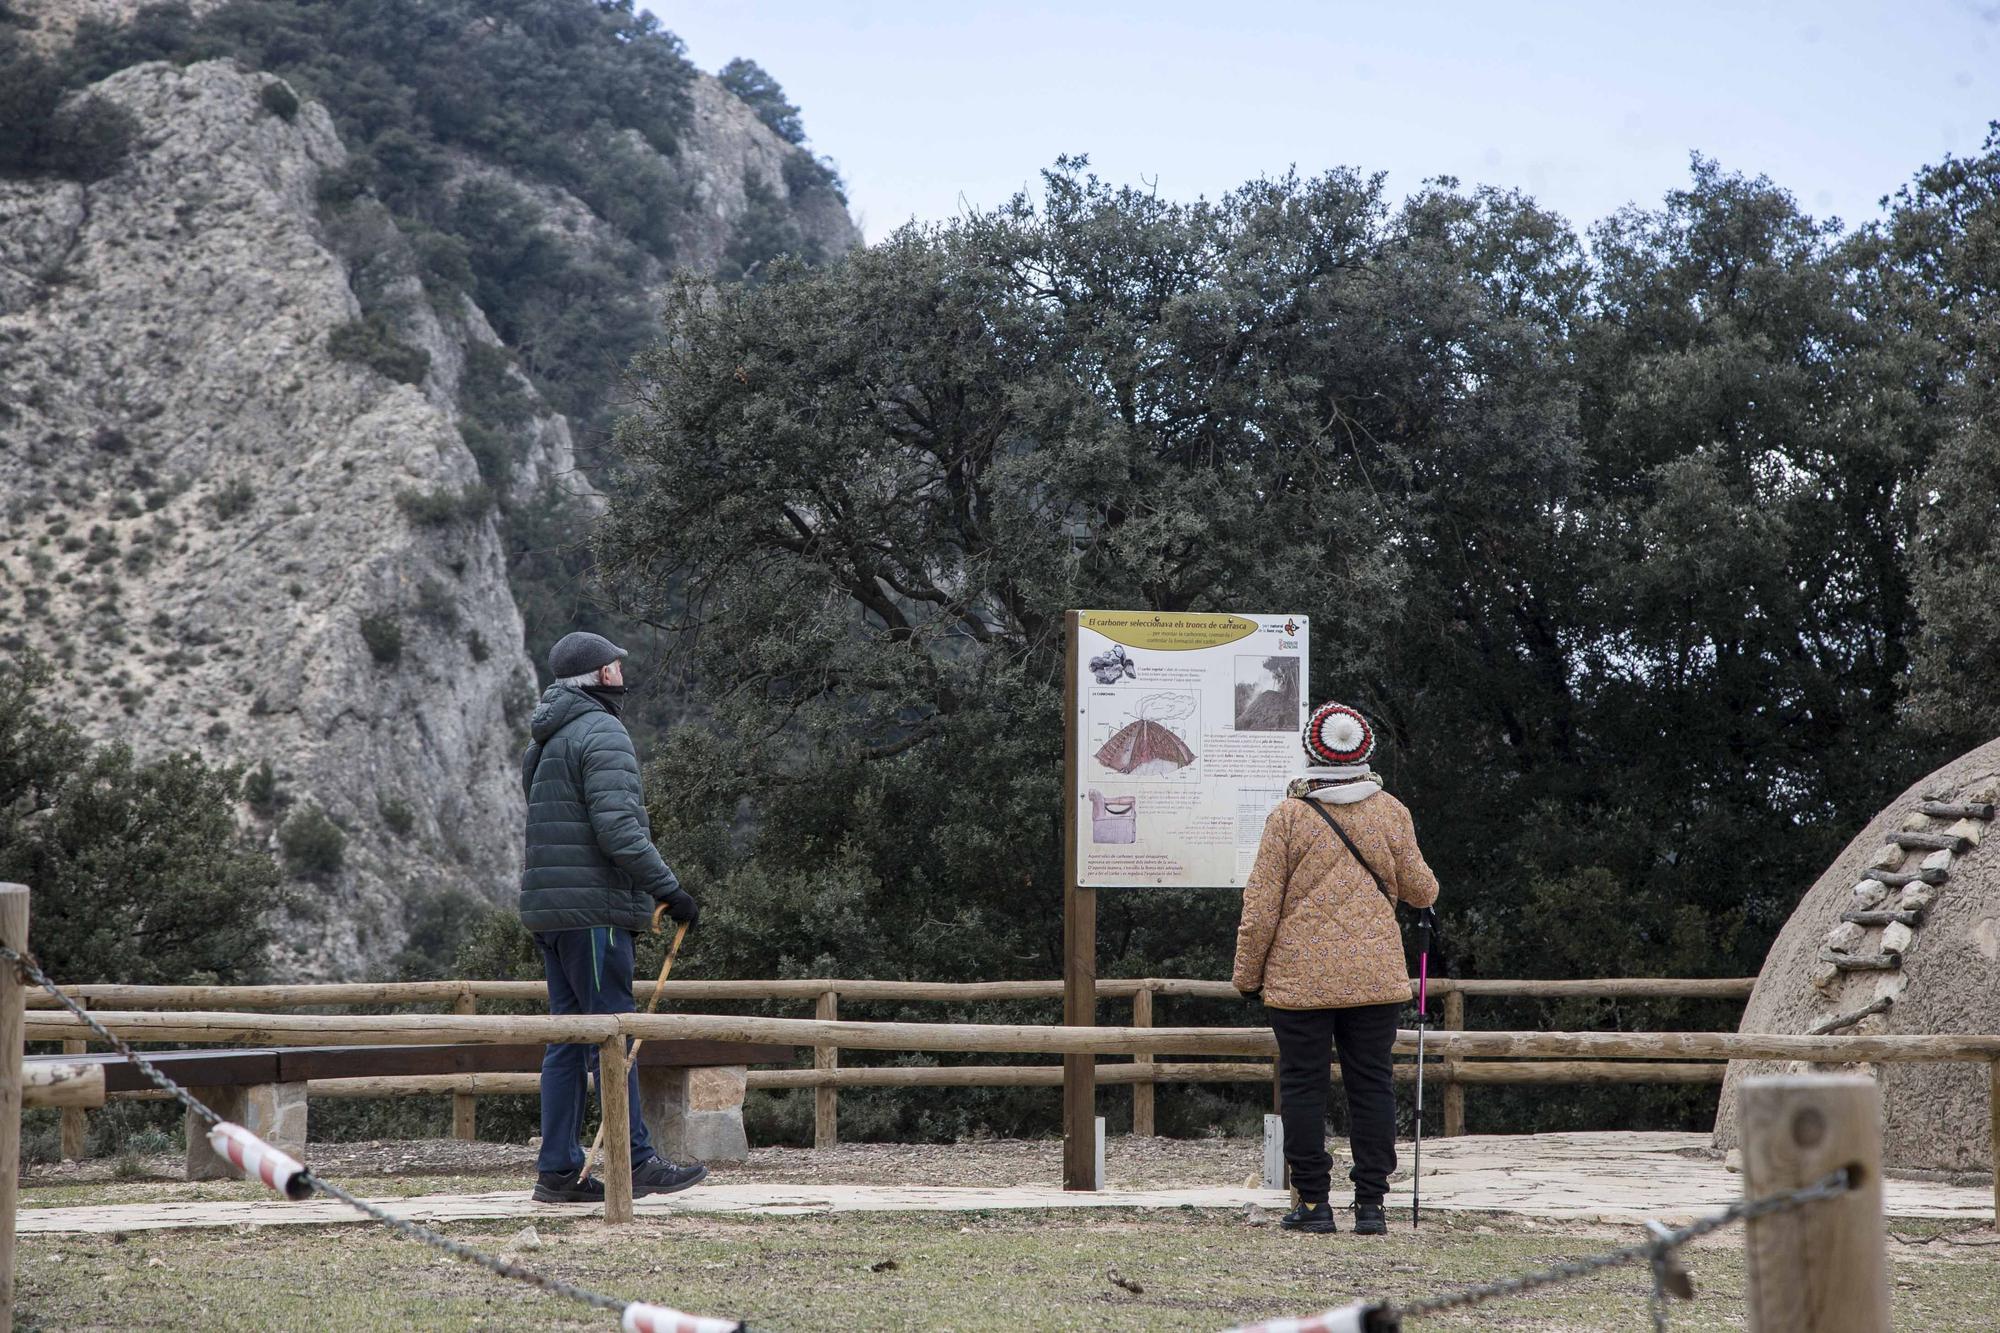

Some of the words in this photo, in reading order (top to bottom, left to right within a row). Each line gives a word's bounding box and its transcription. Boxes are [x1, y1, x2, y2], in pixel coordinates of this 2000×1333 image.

[1089, 618, 1096, 626] El
[1130, 619, 1173, 628] seleccionava
[1208, 621, 1218, 629] de
